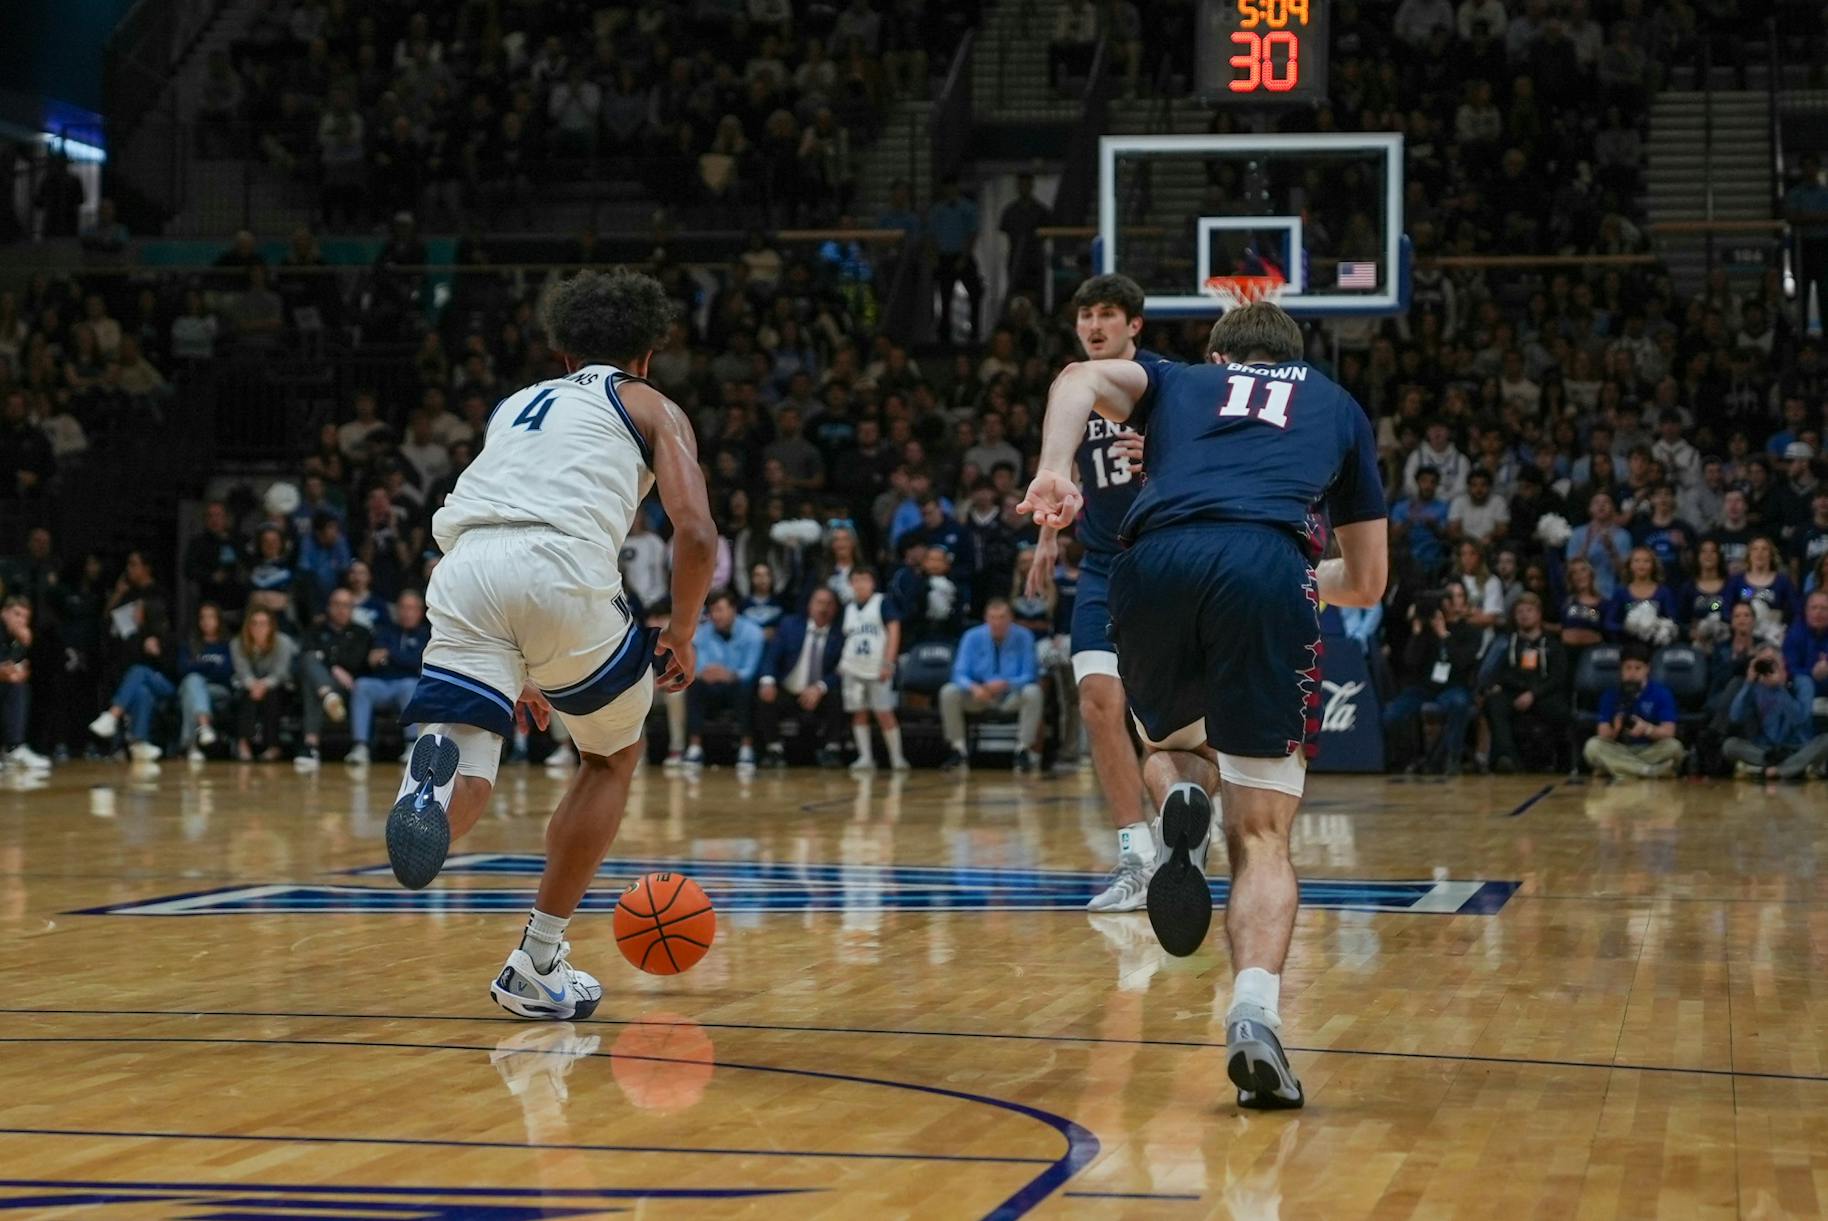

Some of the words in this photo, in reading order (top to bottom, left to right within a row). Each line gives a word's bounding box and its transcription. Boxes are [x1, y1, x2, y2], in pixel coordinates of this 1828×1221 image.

[1228, 31, 1298, 93] 30
[1227, 362, 1308, 381] BROWN
[511, 387, 560, 432] 4
[1219, 374, 1293, 429] 11
[1092, 447, 1132, 489] 13
